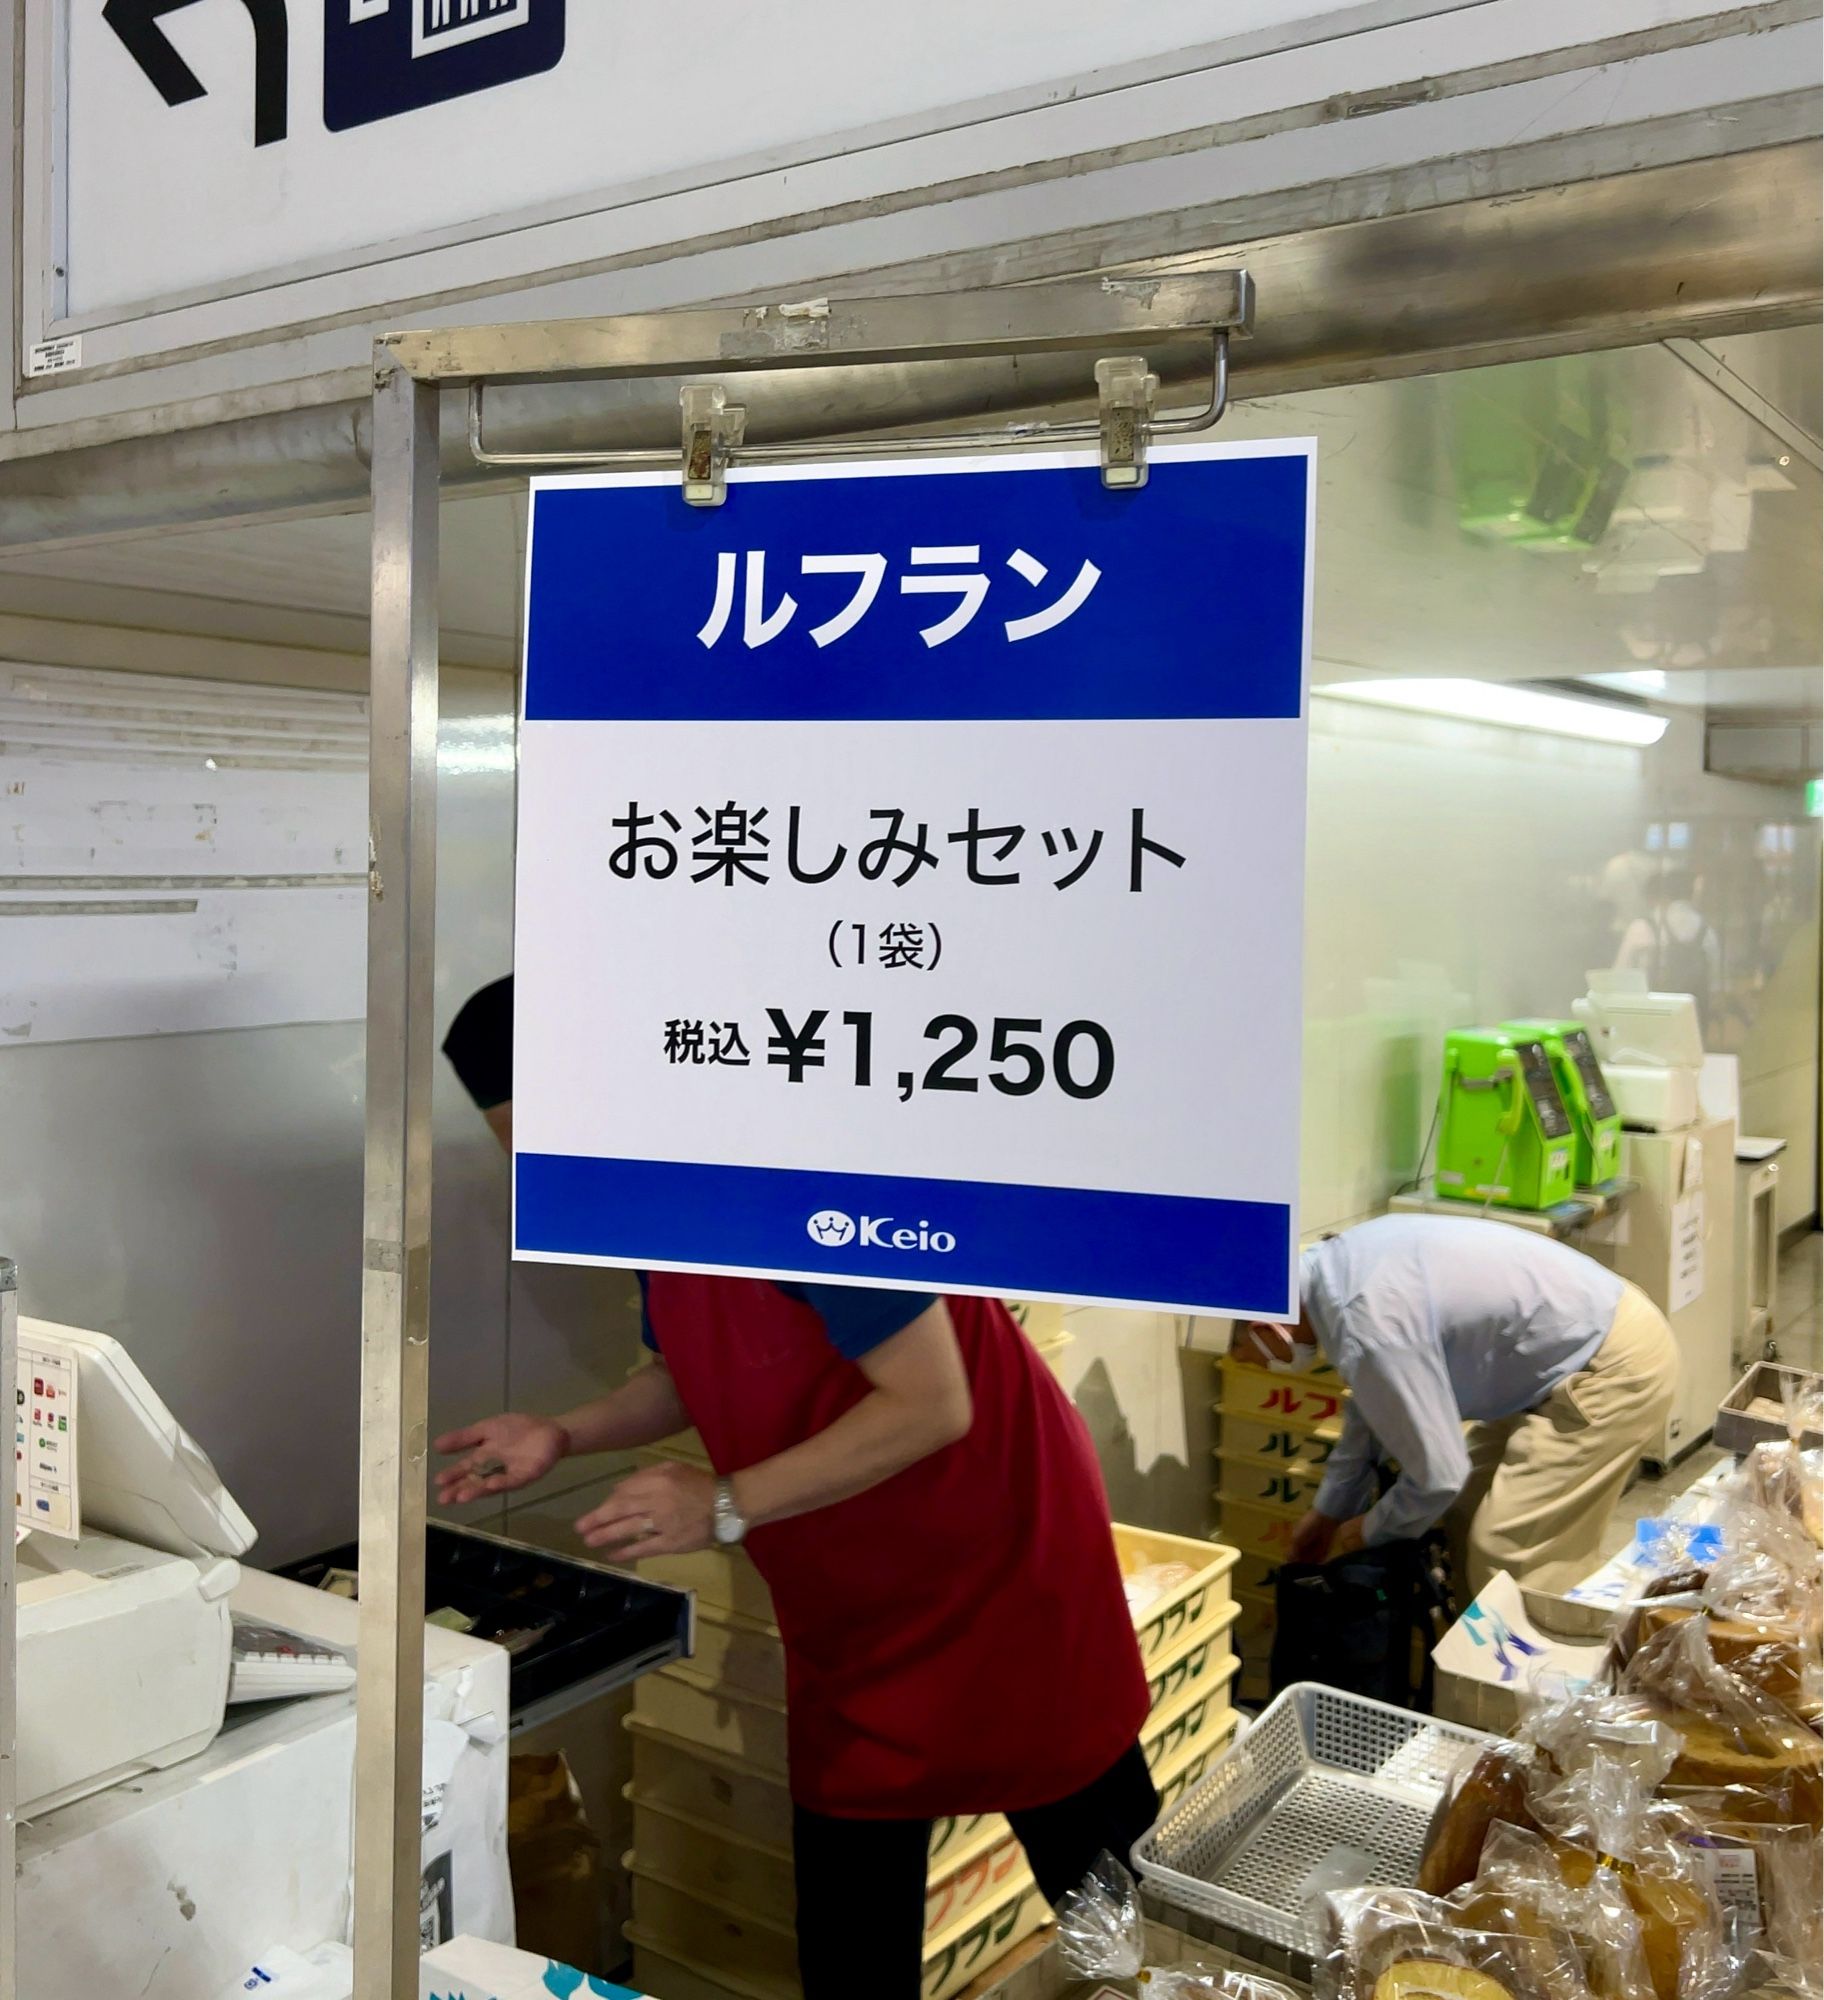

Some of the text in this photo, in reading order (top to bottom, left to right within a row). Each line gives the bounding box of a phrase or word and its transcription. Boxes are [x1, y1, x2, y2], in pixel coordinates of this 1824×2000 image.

[697, 545, 1102, 649] ルフラン
[609, 800, 1186, 893] お楽しみセット
[664, 1008, 1115, 1103] 税込 ¥1,250
[860, 1216, 956, 1252] Keio
[1258, 1387, 1340, 1420] ルフ
[1259, 1431, 1334, 1464] ルフ
